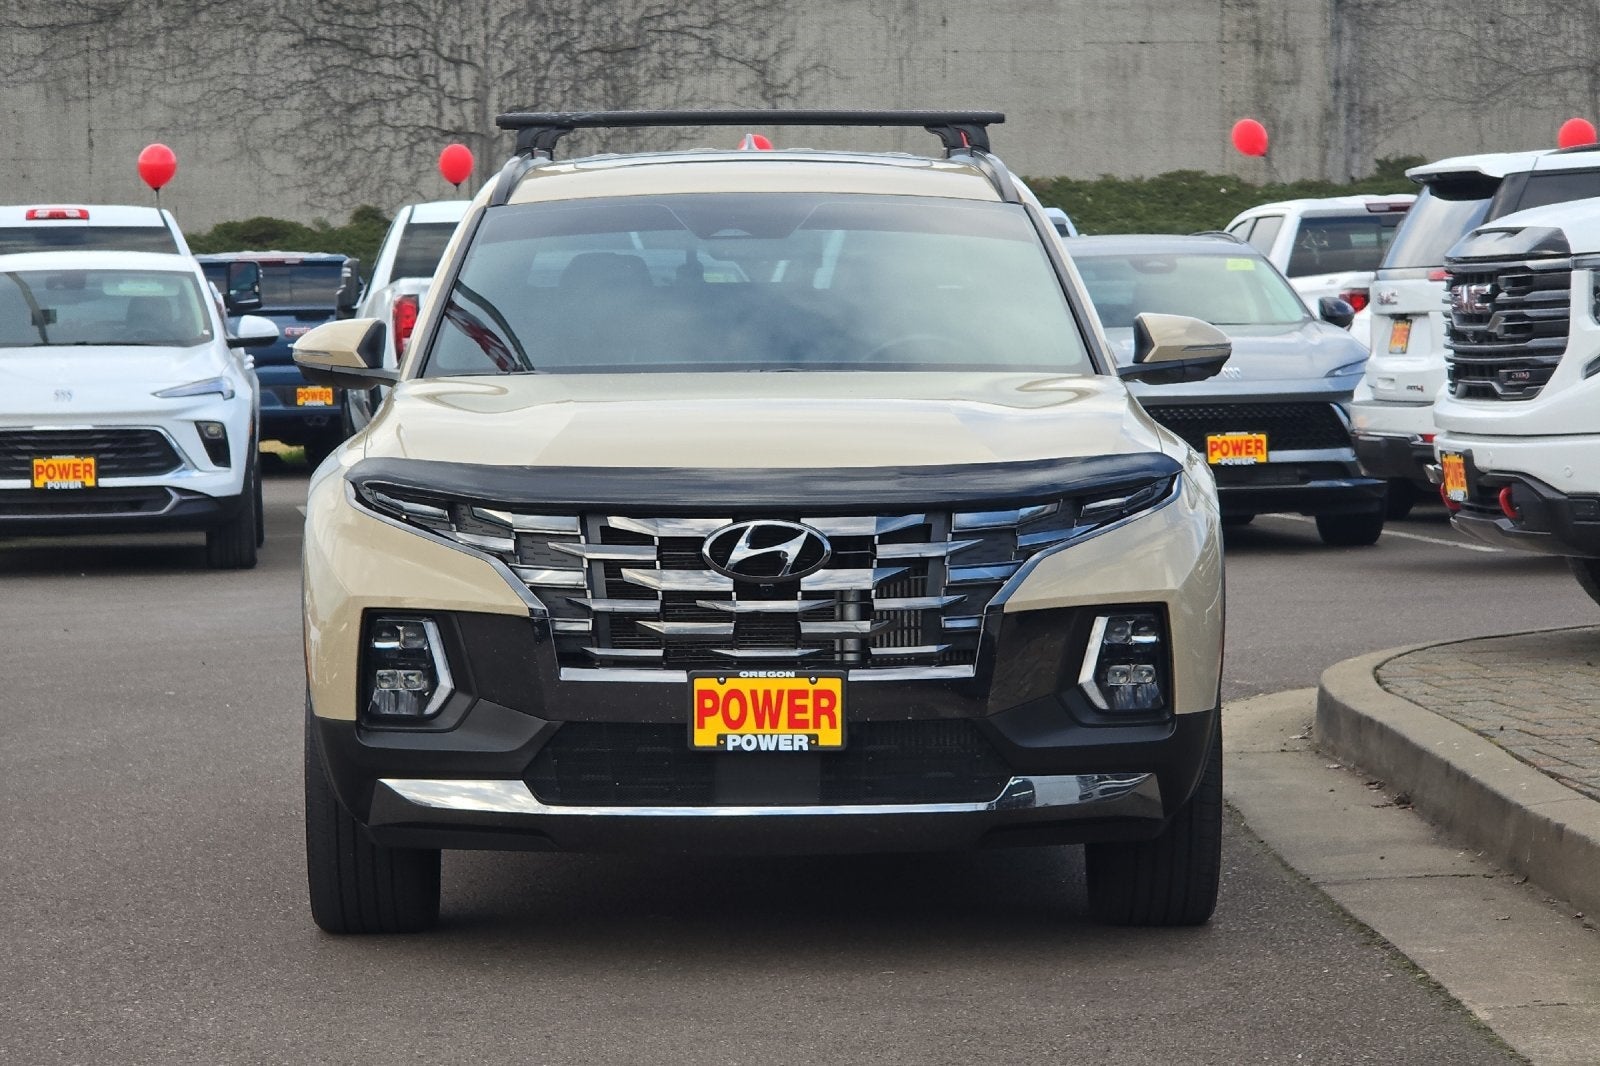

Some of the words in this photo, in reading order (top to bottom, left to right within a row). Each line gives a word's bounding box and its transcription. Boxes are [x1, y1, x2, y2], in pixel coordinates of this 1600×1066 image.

[298, 391, 331, 400] POWER
[1209, 439, 1264, 457] POWER
[35, 463, 93, 480] POWER
[696, 688, 838, 731] POWER
[726, 734, 809, 751] POWER
